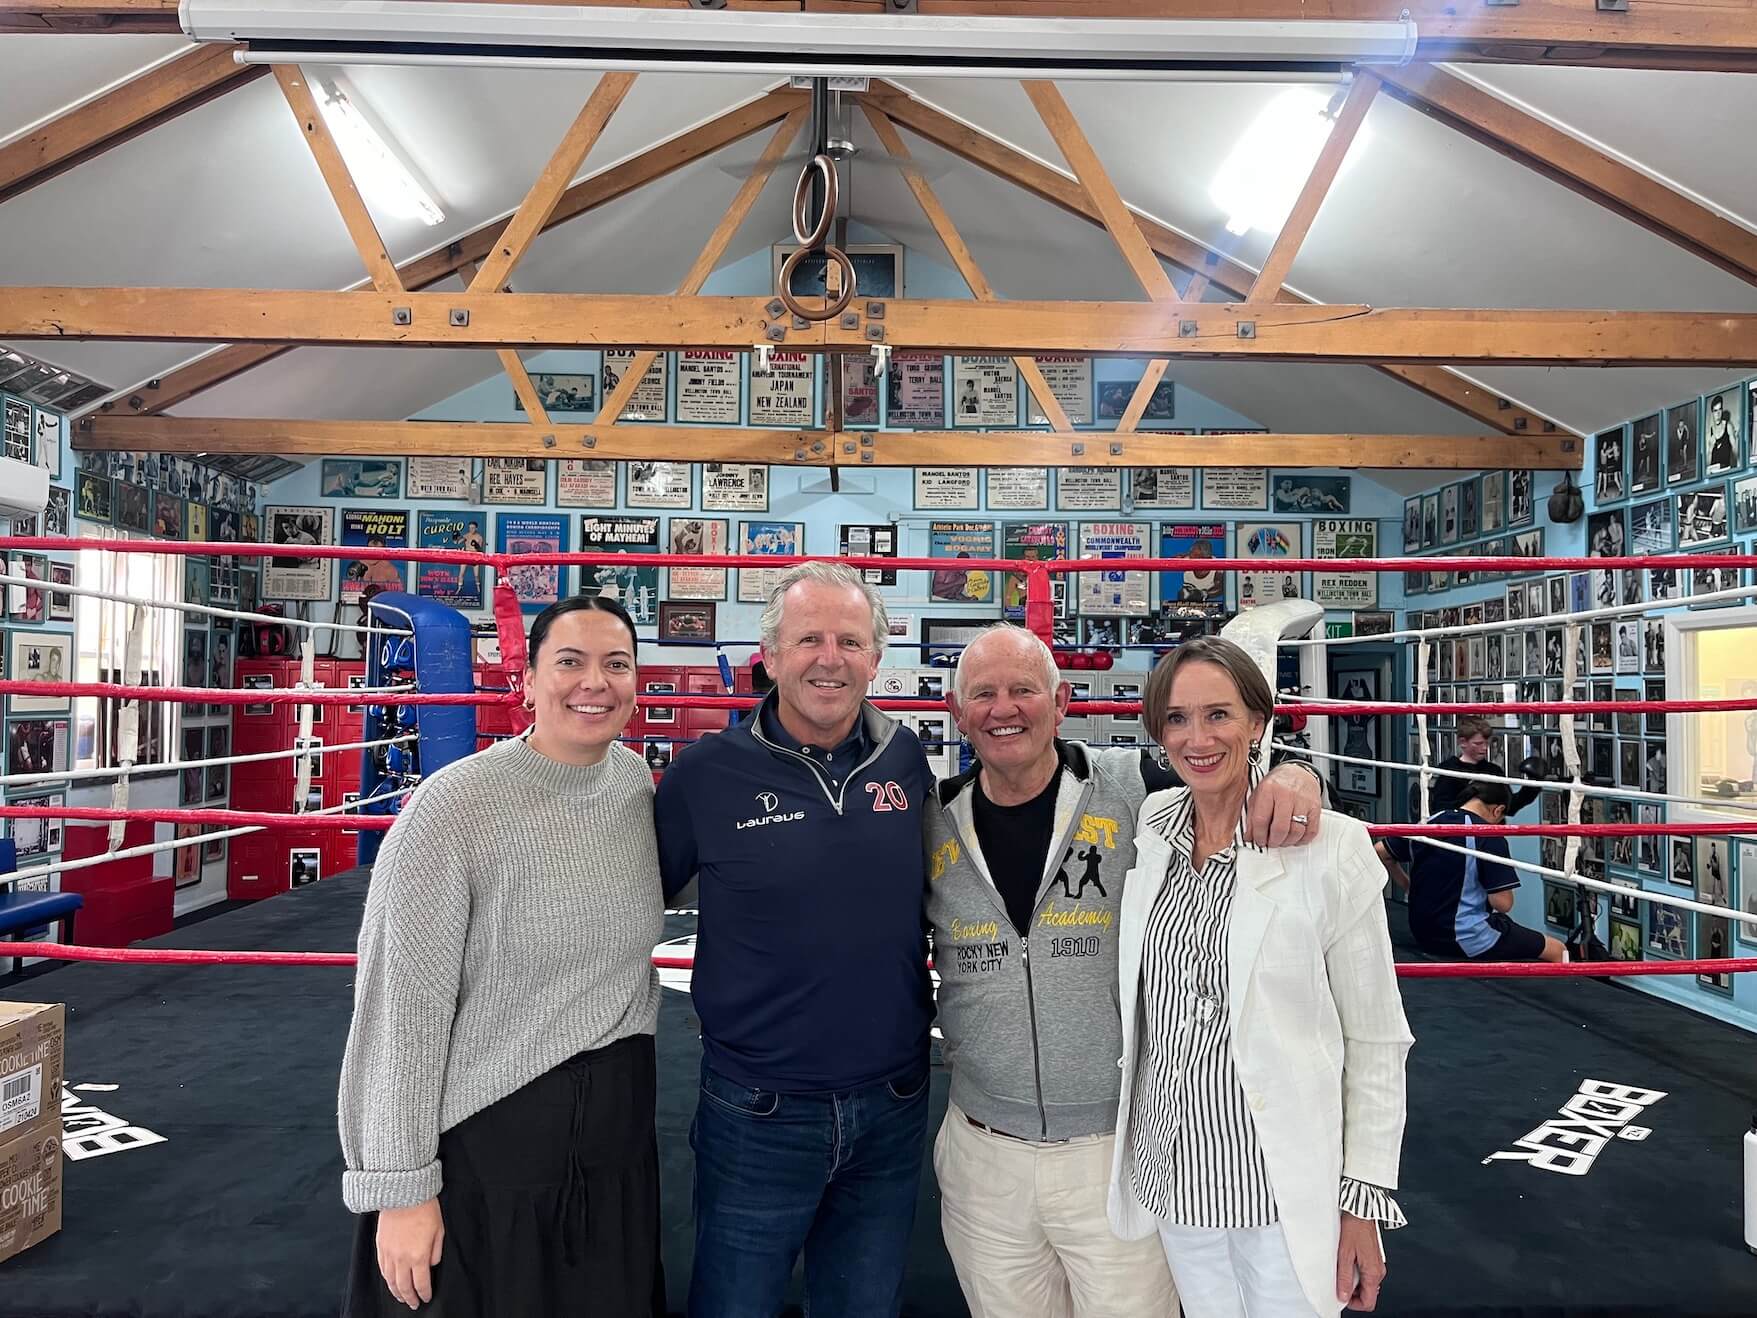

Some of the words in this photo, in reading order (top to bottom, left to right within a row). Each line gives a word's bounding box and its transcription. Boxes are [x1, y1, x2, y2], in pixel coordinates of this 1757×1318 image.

[778, 371, 812, 379] TOURNAMENT
[769, 380, 794, 392] JAPAN
[756, 396, 772, 409] NEW
[775, 396, 807, 409] ZEALAND
[504, 474, 524, 485] HAYES
[708, 478, 745, 488] LAWRENCE
[366, 523, 406, 535] HOLT
[423, 521, 464, 535] CURCIO
[584, 521, 613, 533] EIGHT
[614, 523, 656, 534] MINUTES
[1093, 524, 1135, 535] BOXING
[1318, 521, 1373, 533] BOXING
[589, 532, 603, 542] OF
[604, 533, 650, 543] MAYHEM!
[1086, 537, 1140, 545] COMMONWEALTH
[865, 780, 908, 812] 20
[1073, 813, 1120, 849] ST
[957, 944, 983, 959] ROCKY
[986, 940, 1009, 958] NEW
[1051, 936, 1100, 958] 1910
[957, 960, 977, 974] YORK
[980, 958, 1004, 973] CITY
[1481, 1078, 1670, 1176] BOXER
[2, 1171, 44, 1209] COOKIE
[21, 1186, 50, 1218] TIME
